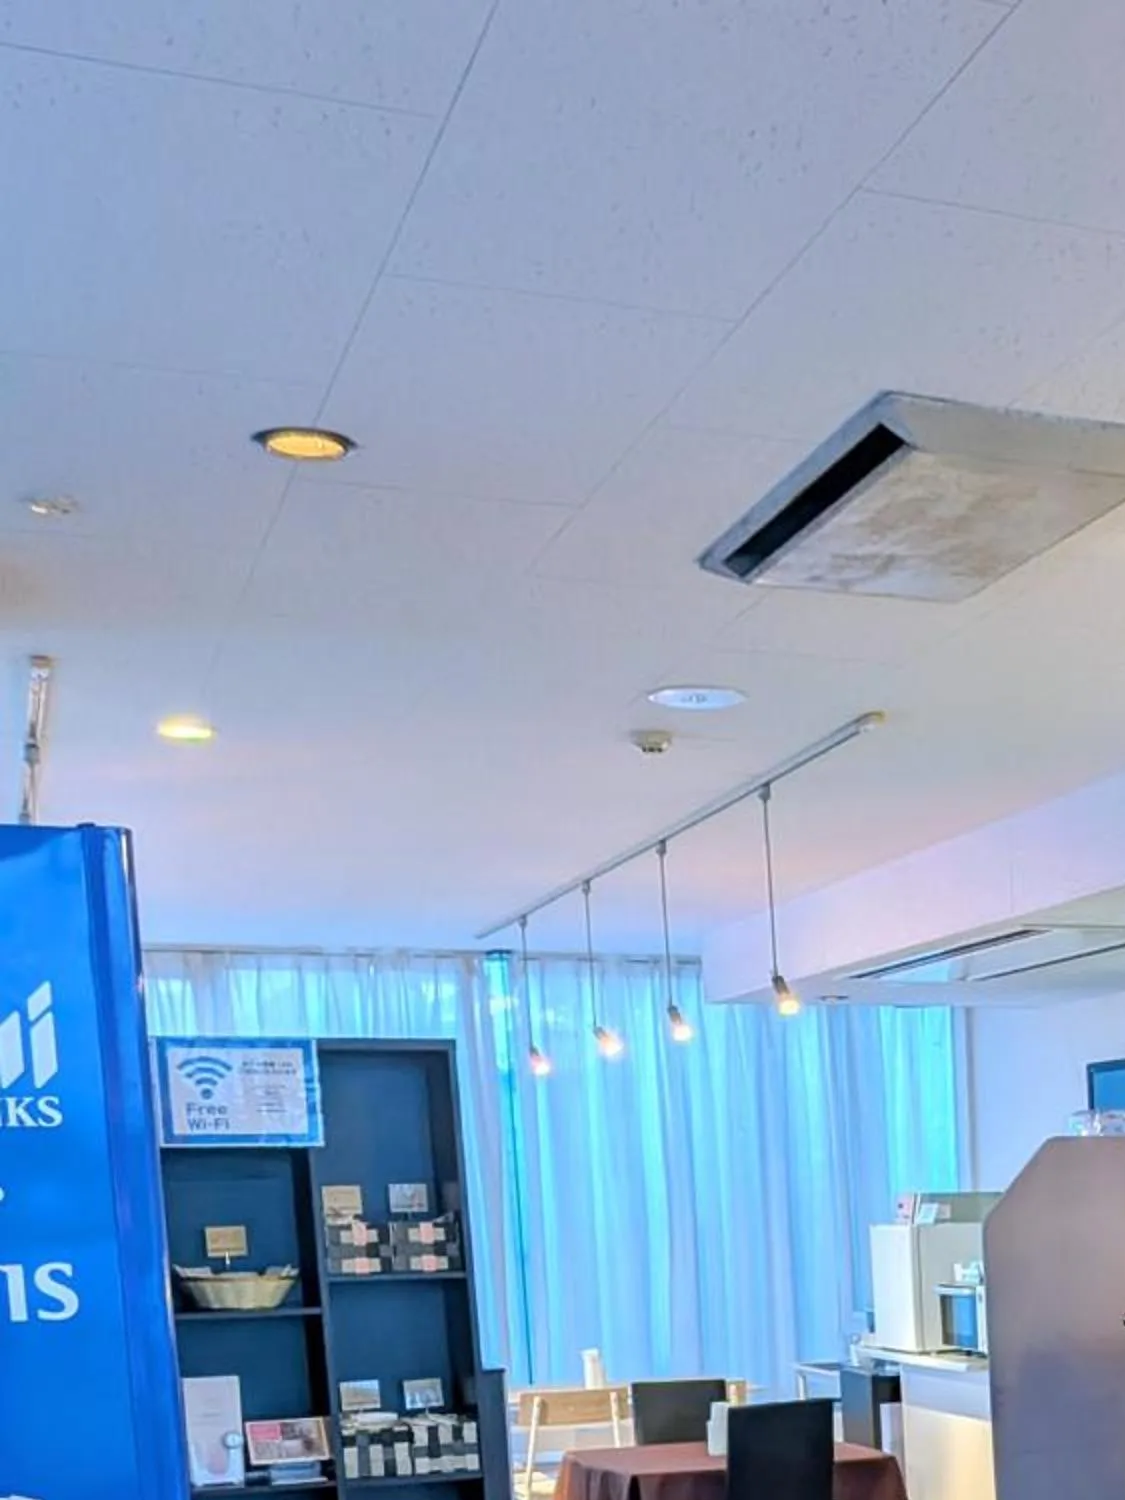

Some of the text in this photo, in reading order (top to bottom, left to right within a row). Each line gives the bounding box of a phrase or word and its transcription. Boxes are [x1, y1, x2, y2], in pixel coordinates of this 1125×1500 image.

[0, 1095, 63, 1128] KS
[186, 1103, 228, 1116] Free
[188, 1118, 230, 1131] Wi-Fi
